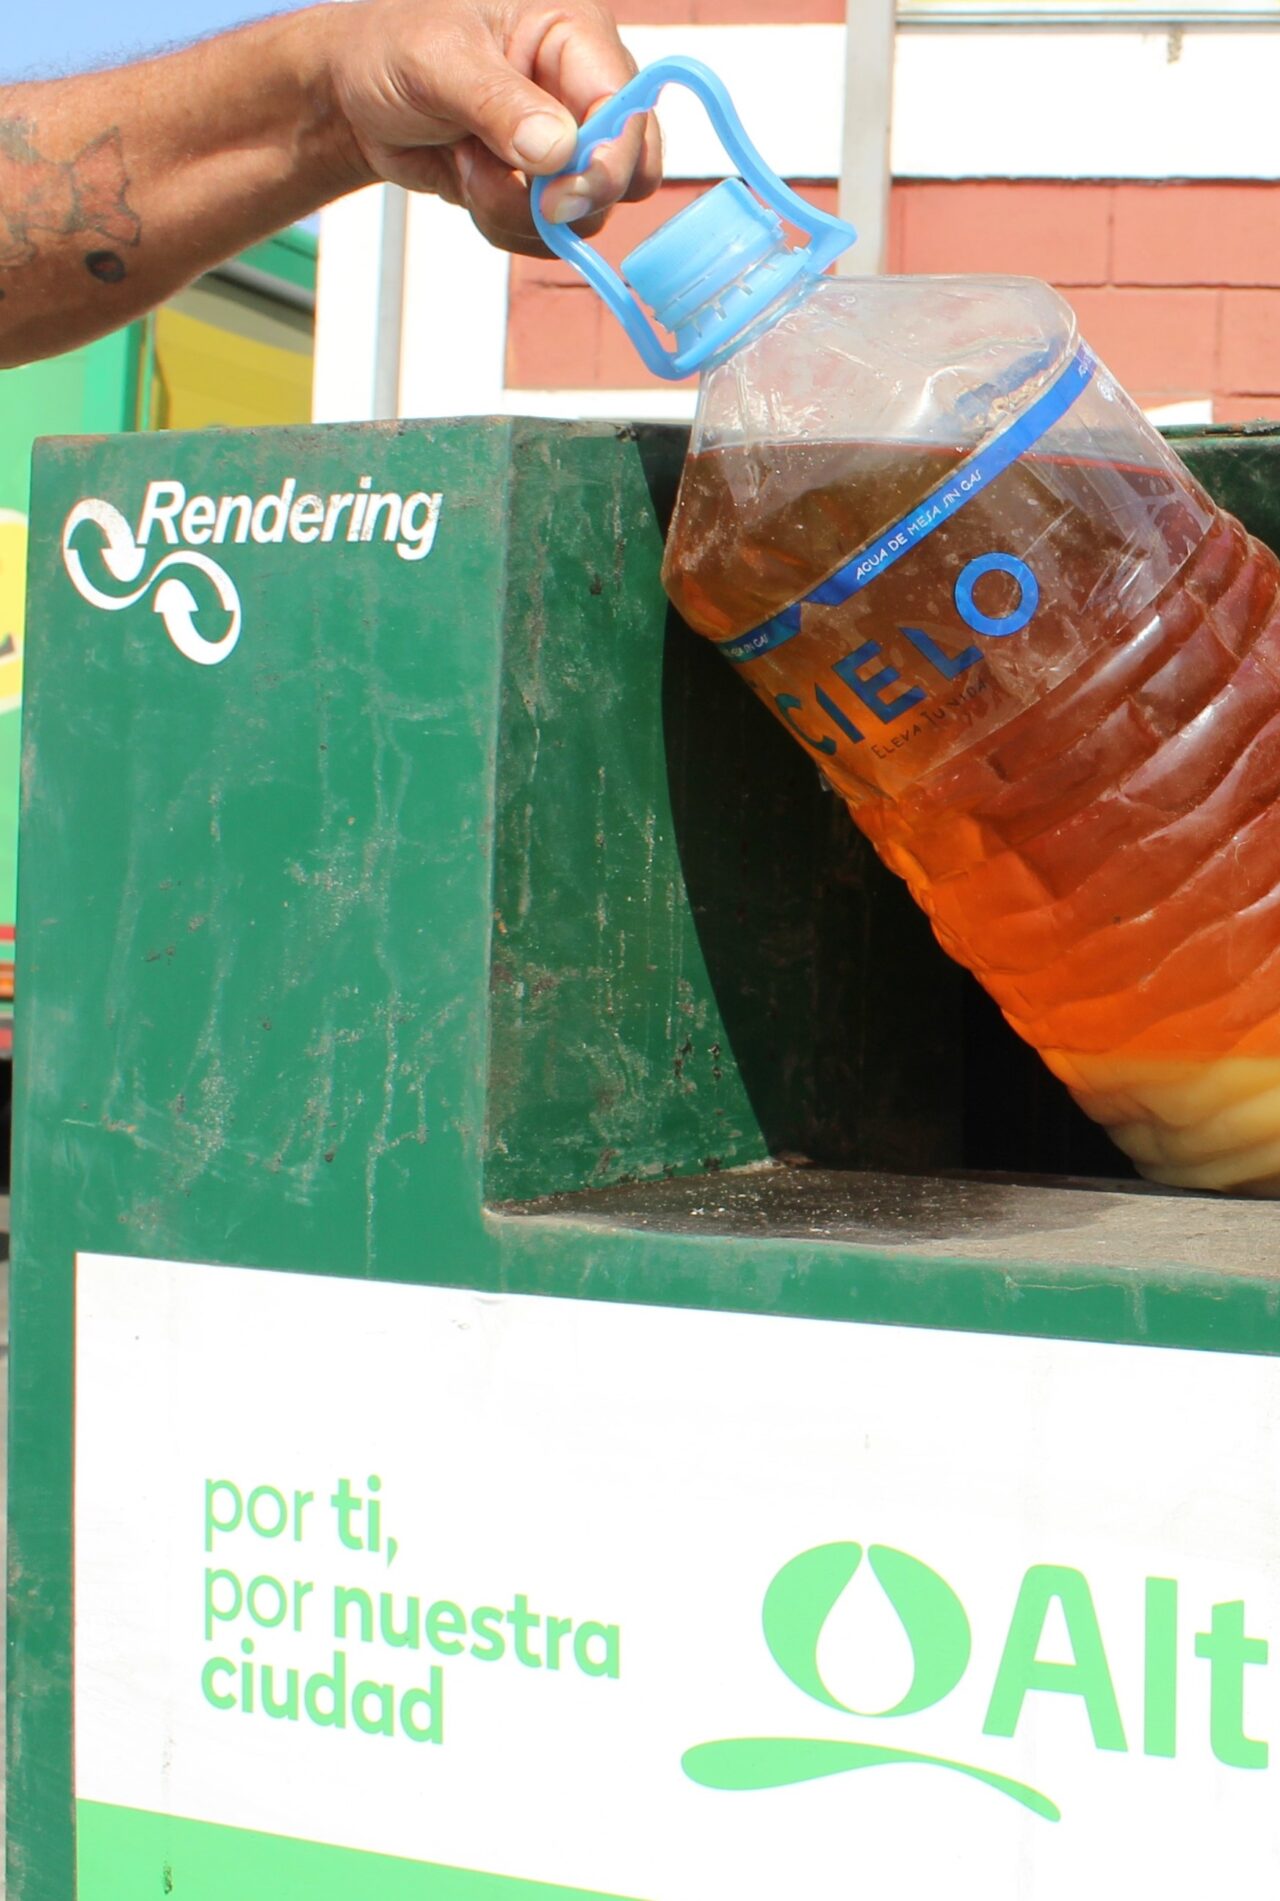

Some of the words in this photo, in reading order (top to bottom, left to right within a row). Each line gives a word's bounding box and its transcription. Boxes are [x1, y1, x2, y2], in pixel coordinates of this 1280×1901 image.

[136, 476, 444, 561] Rendering
[856, 548, 889, 580] AGUA
[887, 533, 908, 552] DE
[907, 505, 942, 536] MESA
[942, 488, 961, 509] SIN
[960, 469, 982, 491] GAS
[775, 551, 1040, 757] CIELO
[870, 724, 922, 759] ELEVA
[205, 1478, 314, 1552] por
[330, 1474, 399, 1569] ti,
[205, 1567, 314, 1640] por
[333, 1594, 621, 1679] nuestra
[201, 1637, 444, 1745] ciudad
